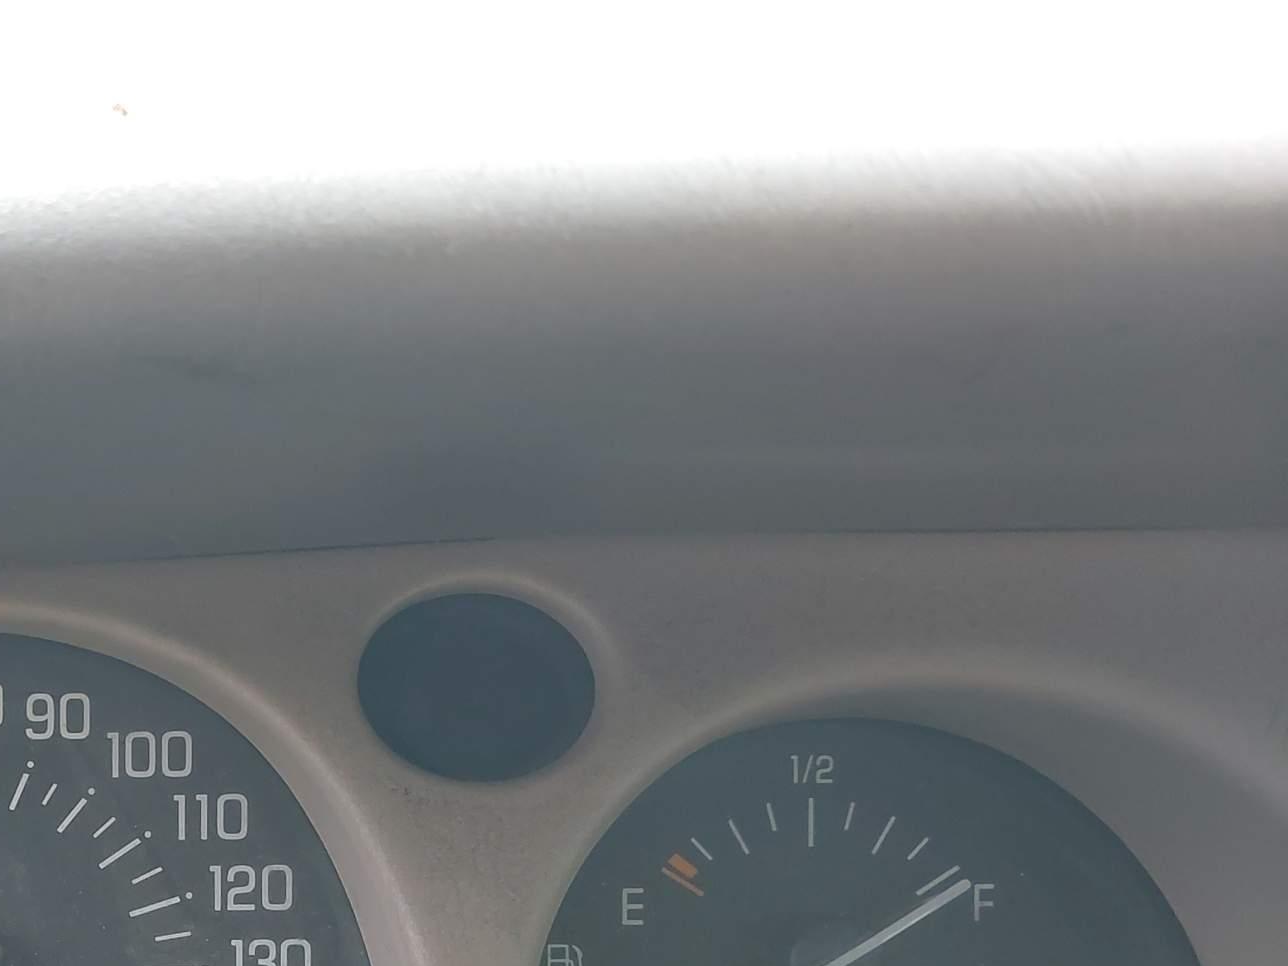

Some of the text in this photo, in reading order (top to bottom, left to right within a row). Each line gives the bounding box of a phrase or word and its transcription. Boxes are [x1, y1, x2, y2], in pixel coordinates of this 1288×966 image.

[25, 693, 91, 740] 90
[106, 730, 193, 778] 100
[790, 754, 834, 784] 1/2
[173, 793, 249, 840] 110
[209, 864, 293, 912] 120
[622, 888, 645, 925] E
[974, 883, 996, 921] F
